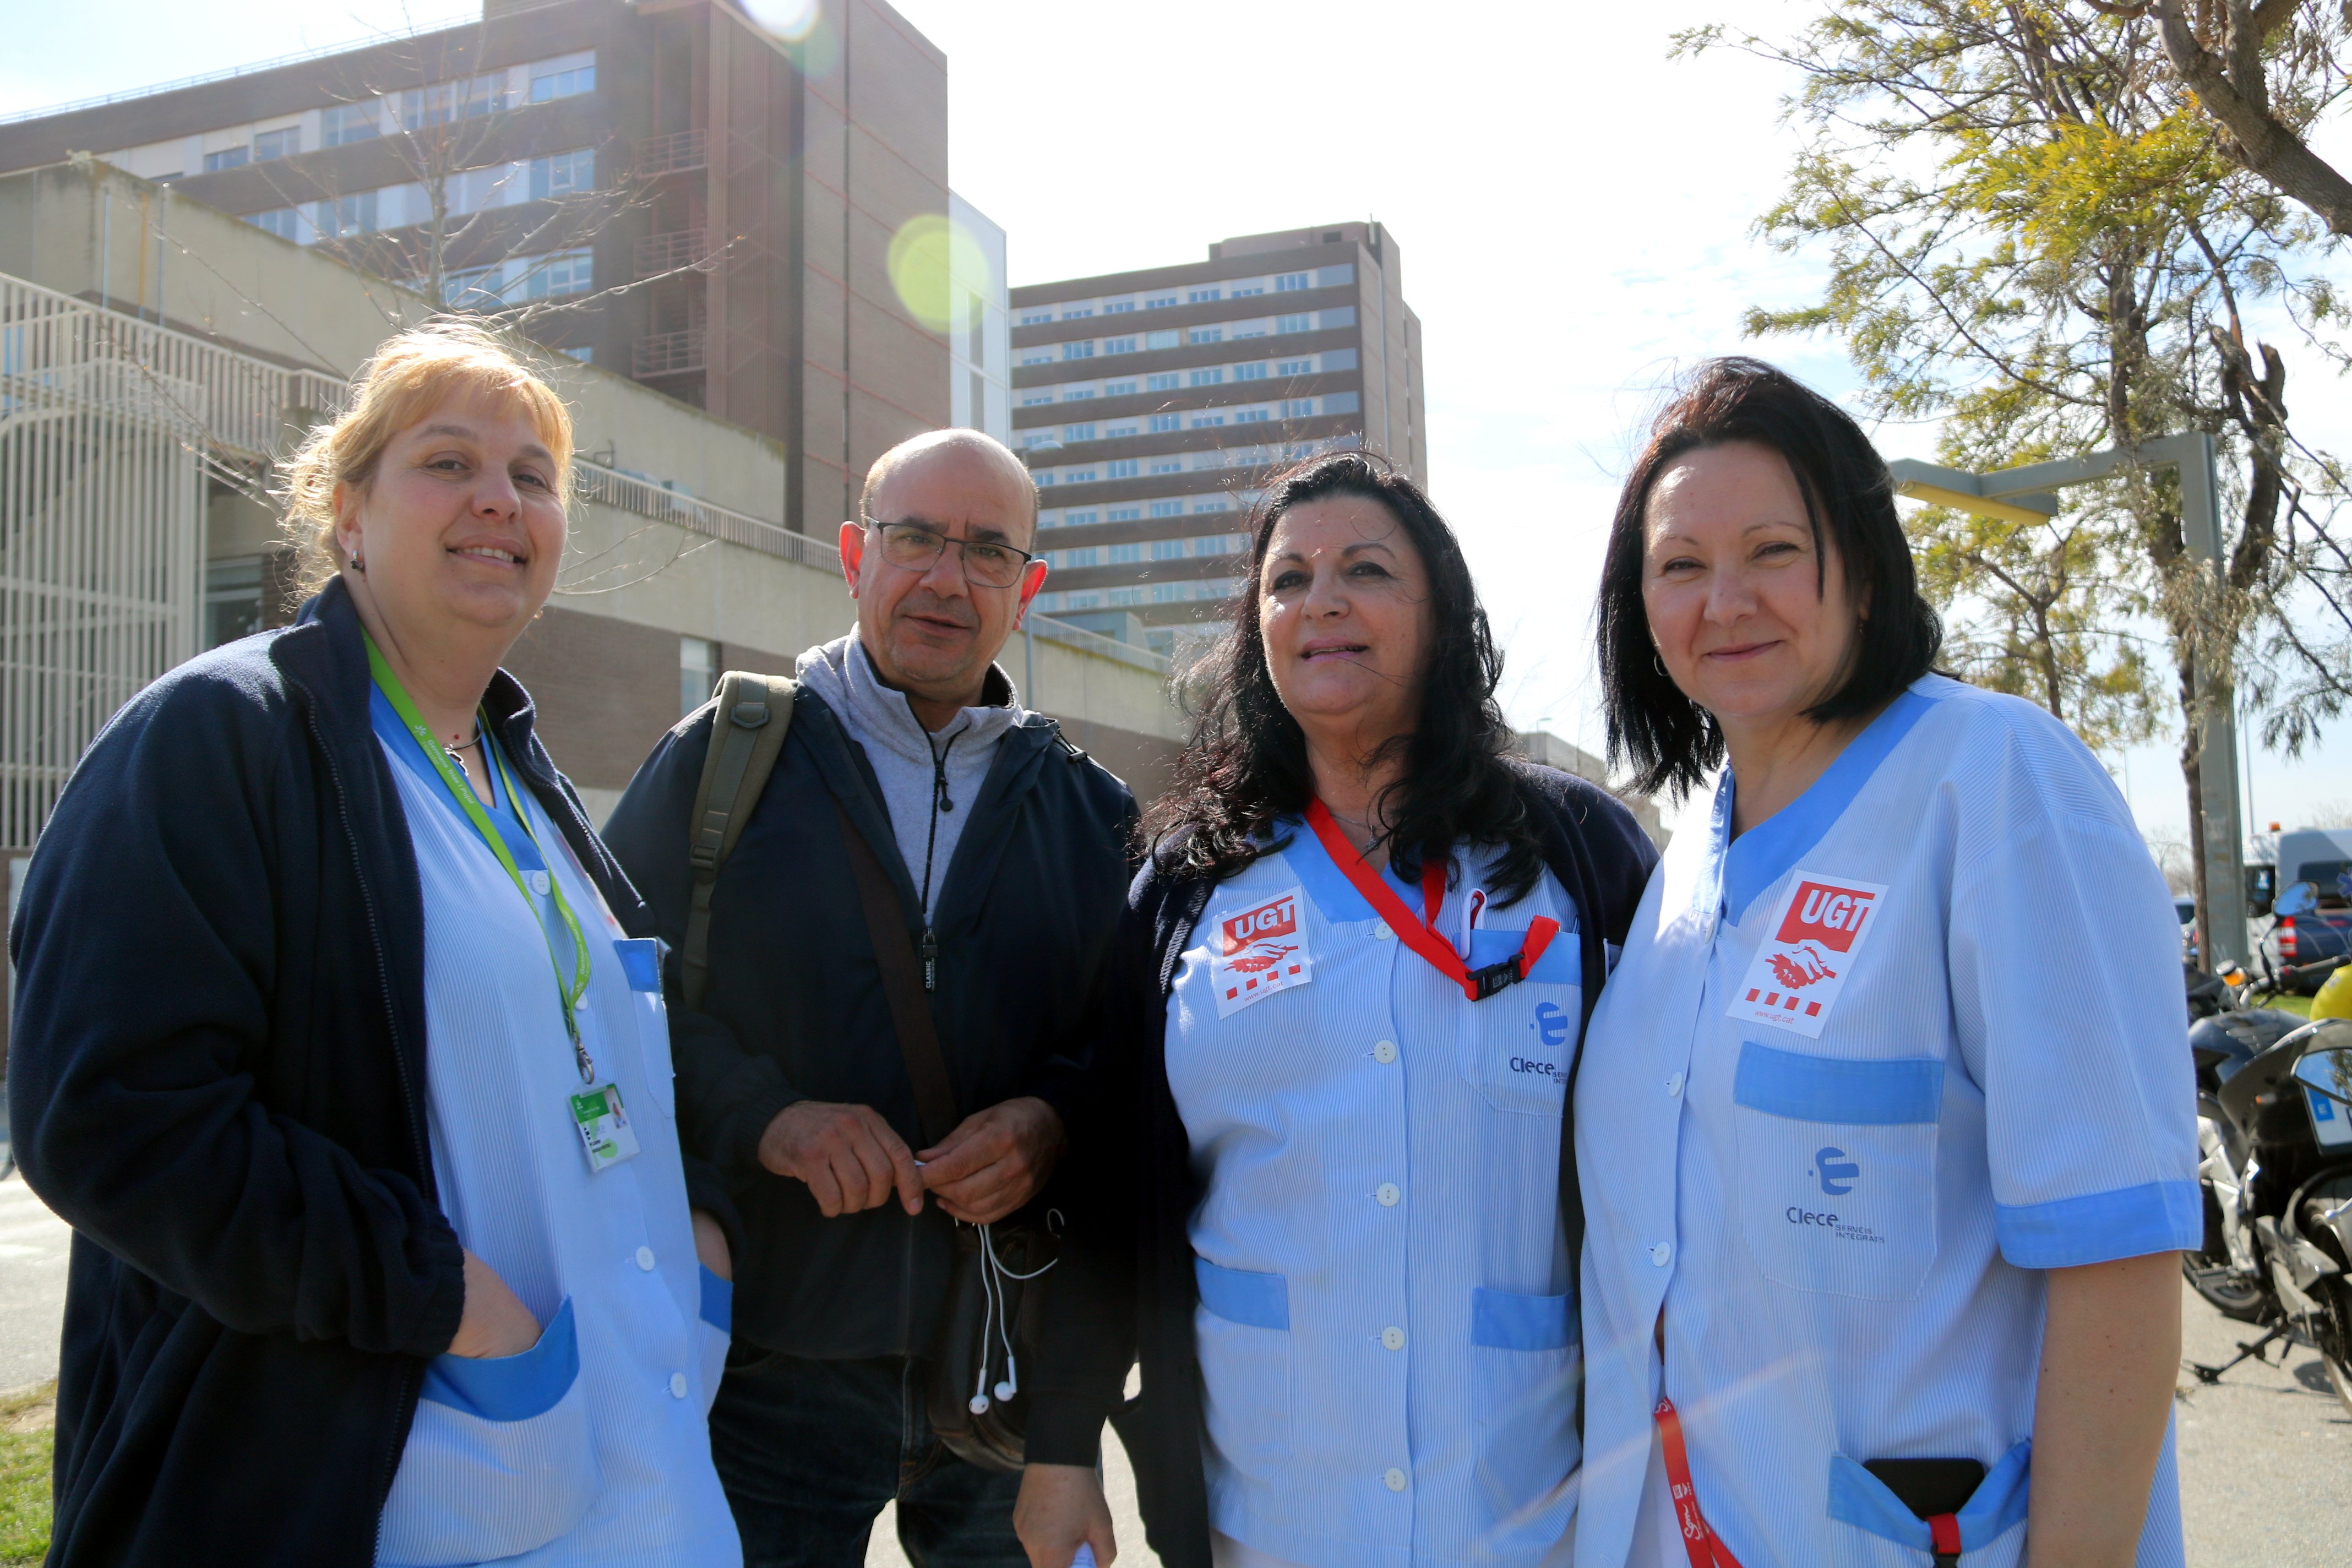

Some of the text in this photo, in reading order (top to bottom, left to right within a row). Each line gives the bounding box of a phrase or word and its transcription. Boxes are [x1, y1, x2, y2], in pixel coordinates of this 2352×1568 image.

[427, 739, 449, 769] Germans
[447, 769, 460, 785] Trias
[460, 787, 475, 804] Pujol
[1235, 901, 1294, 939] UGT
[1800, 889, 1874, 932] UGT
[1244, 981, 1284, 1002] www.ugt.cat
[1754, 1009, 1794, 1024] www.ugt.cat
[1510, 1057, 1555, 1075] Clece
[1786, 1206, 1838, 1227] Clece
[1836, 1224, 1872, 1234] SERVEIS
[1836, 1232, 1885, 1243] INTEGRATS
